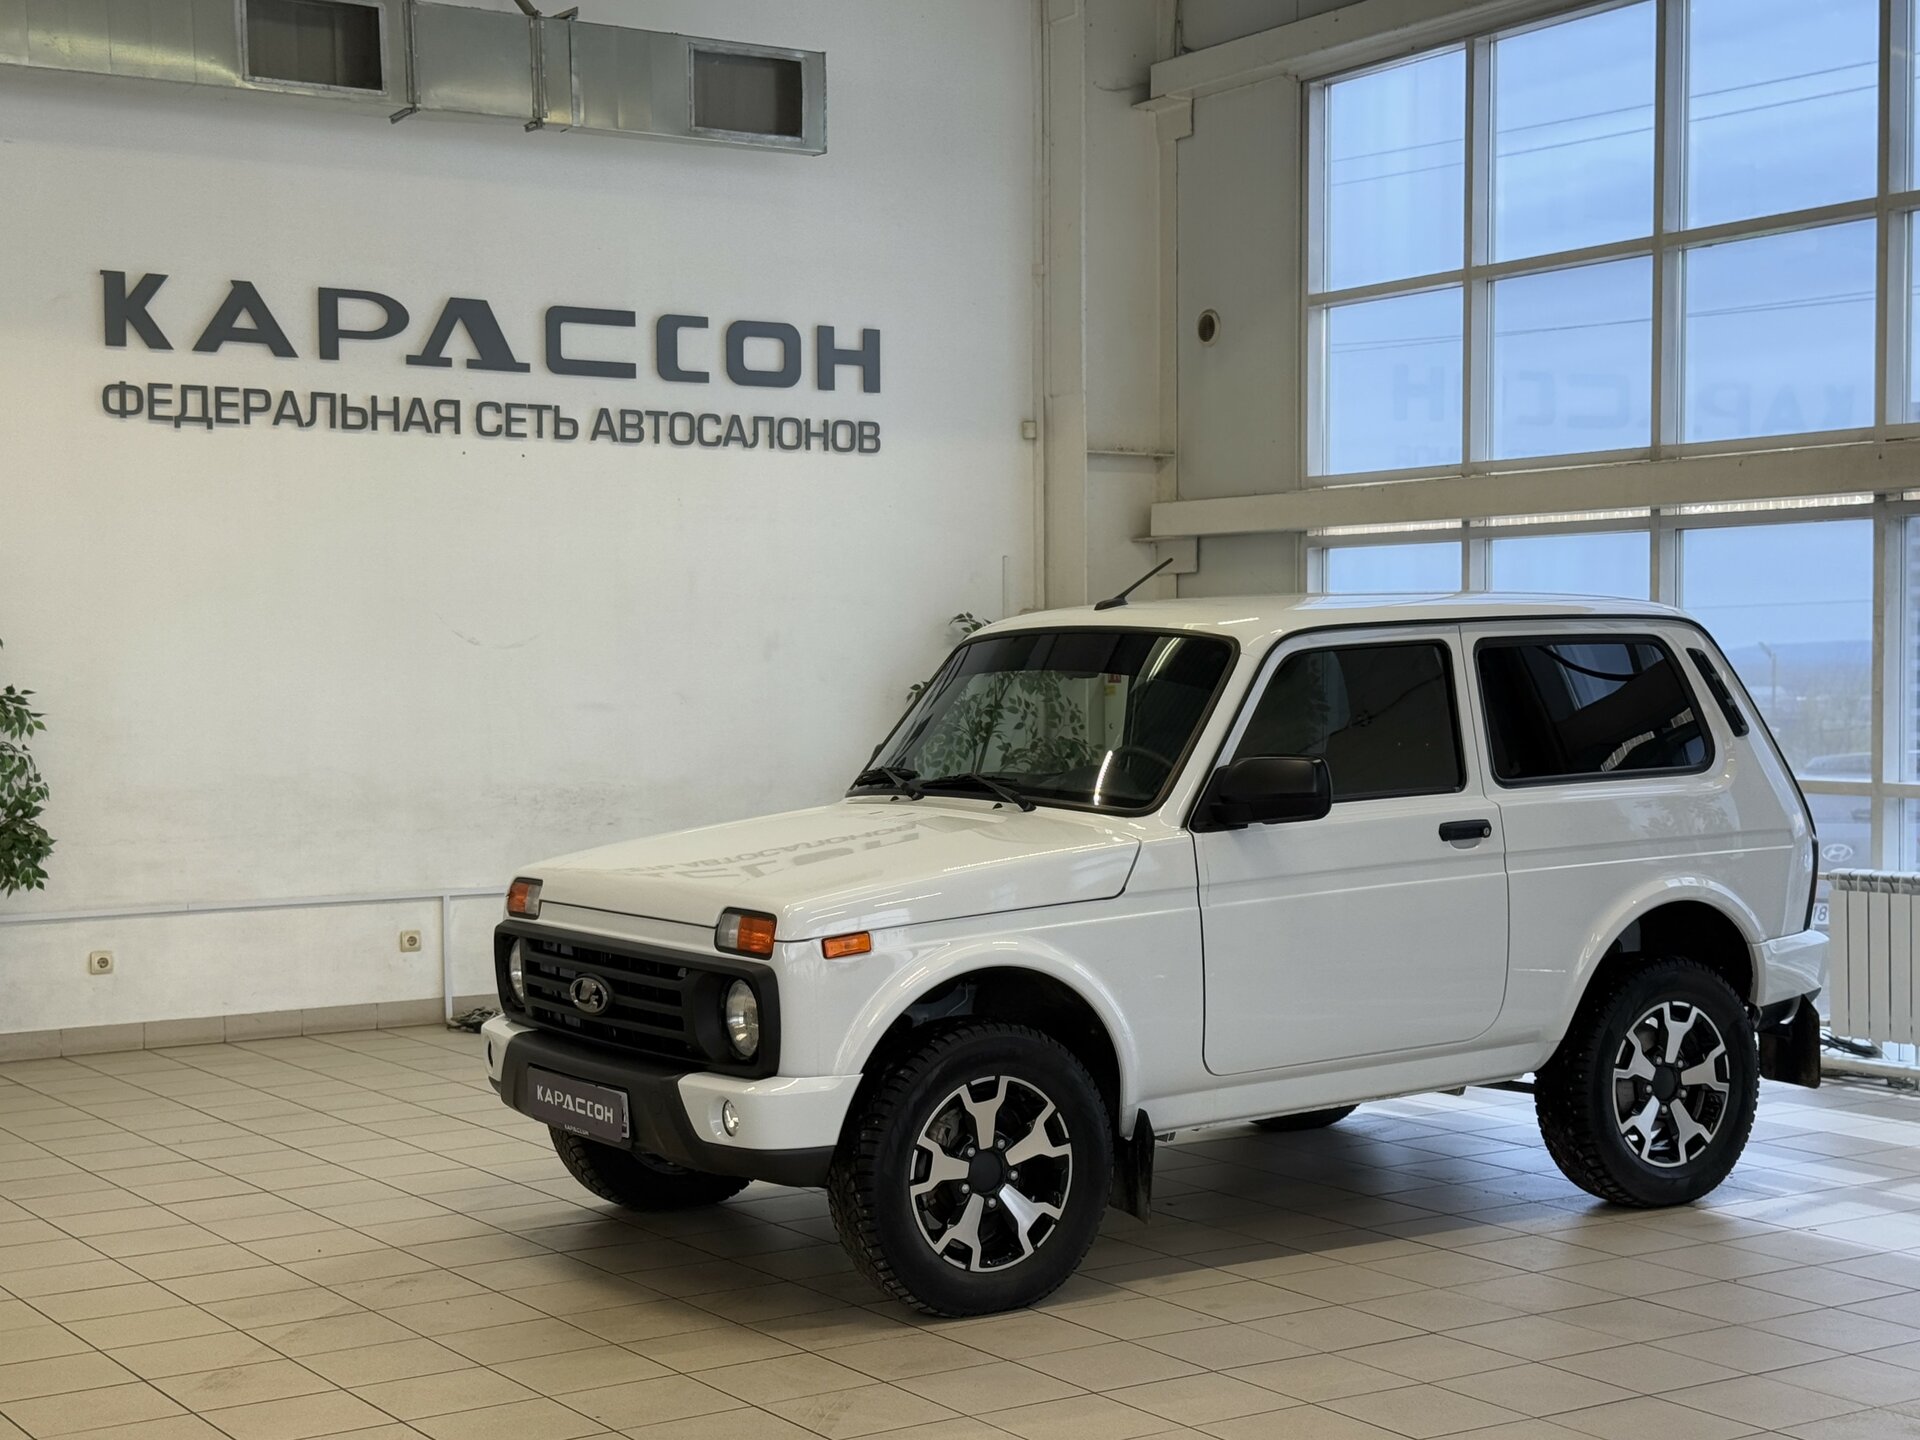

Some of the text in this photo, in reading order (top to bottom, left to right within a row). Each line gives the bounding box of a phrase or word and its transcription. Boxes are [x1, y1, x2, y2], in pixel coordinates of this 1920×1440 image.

[101, 380, 881, 454] ФЕДЕРАЛЬНАЯ СЕТЬ АВТОСАЛОНОВ
